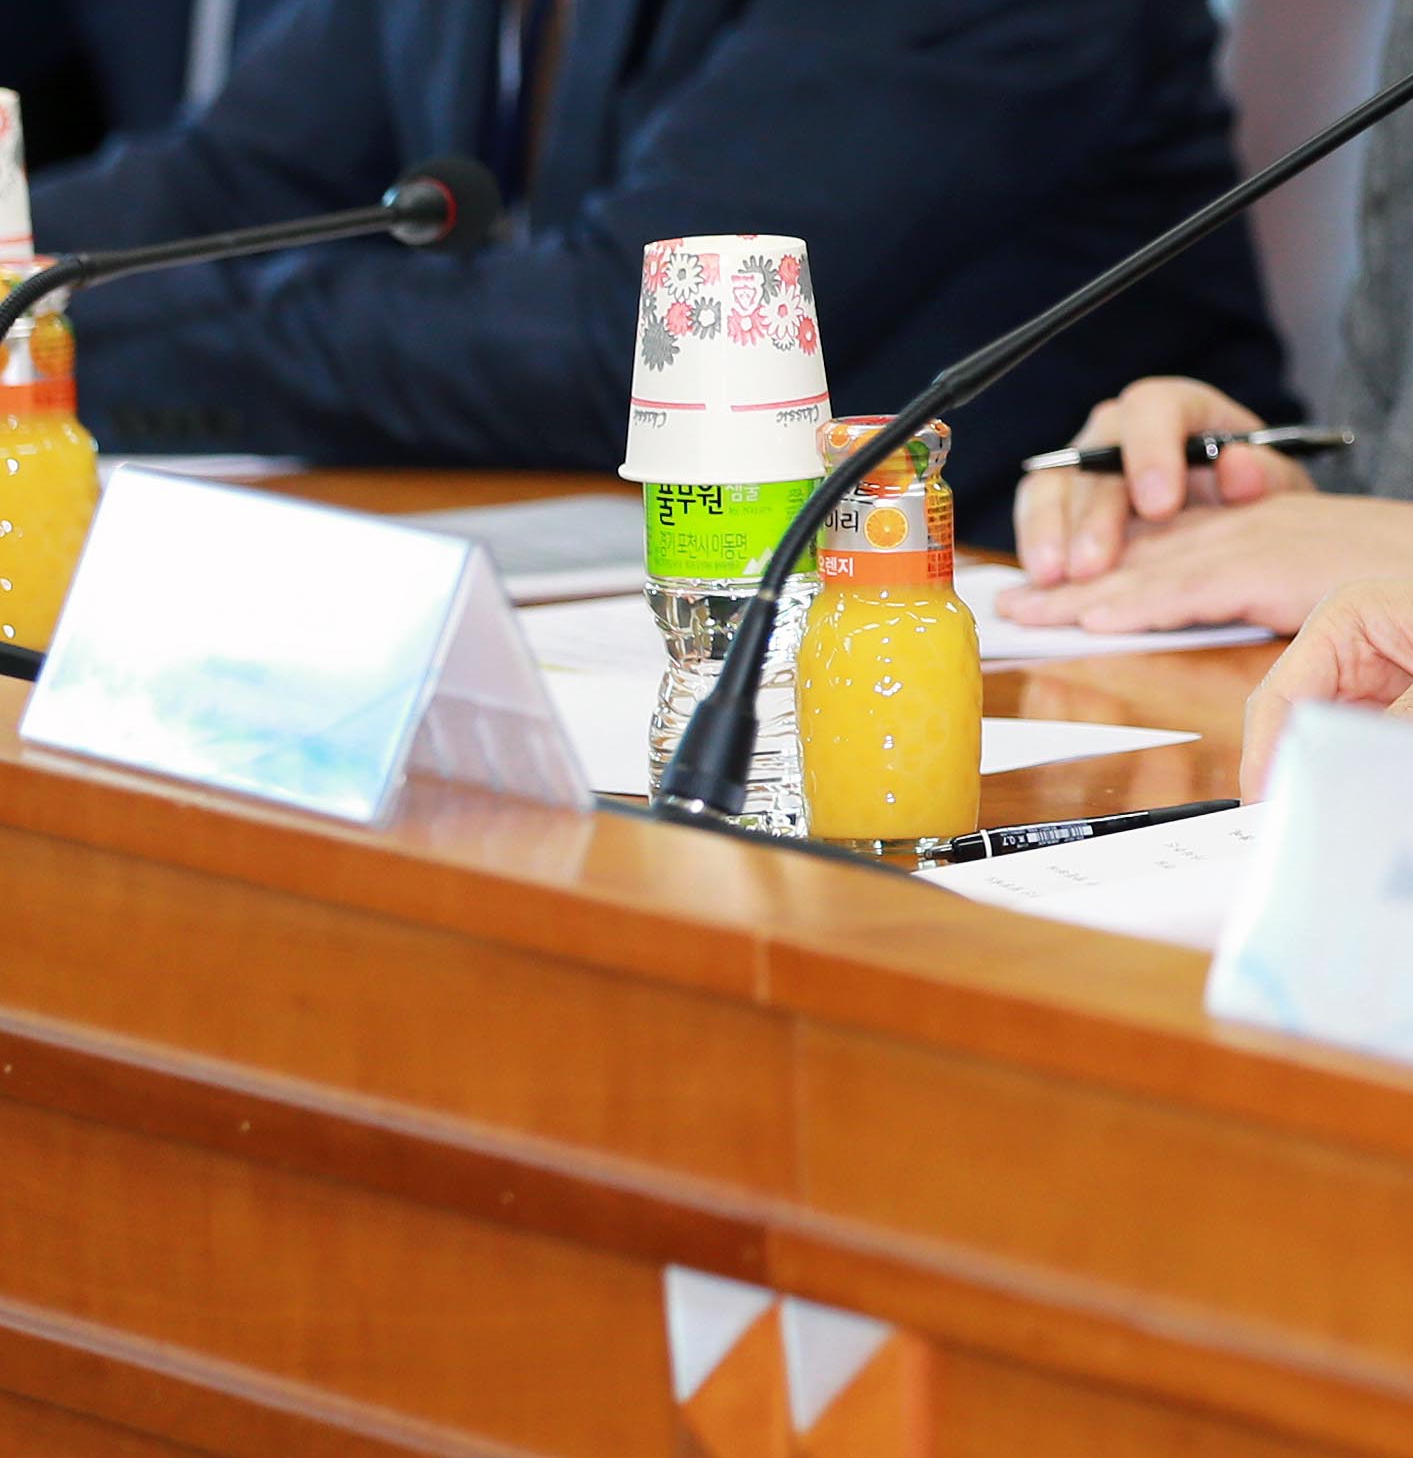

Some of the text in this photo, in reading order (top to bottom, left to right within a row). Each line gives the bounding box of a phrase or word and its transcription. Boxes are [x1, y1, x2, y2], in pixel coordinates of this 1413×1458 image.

[656, 484, 724, 526] 풀무원
[825, 510, 859, 533] 이리
[818, 556, 854, 577] 오렌지
